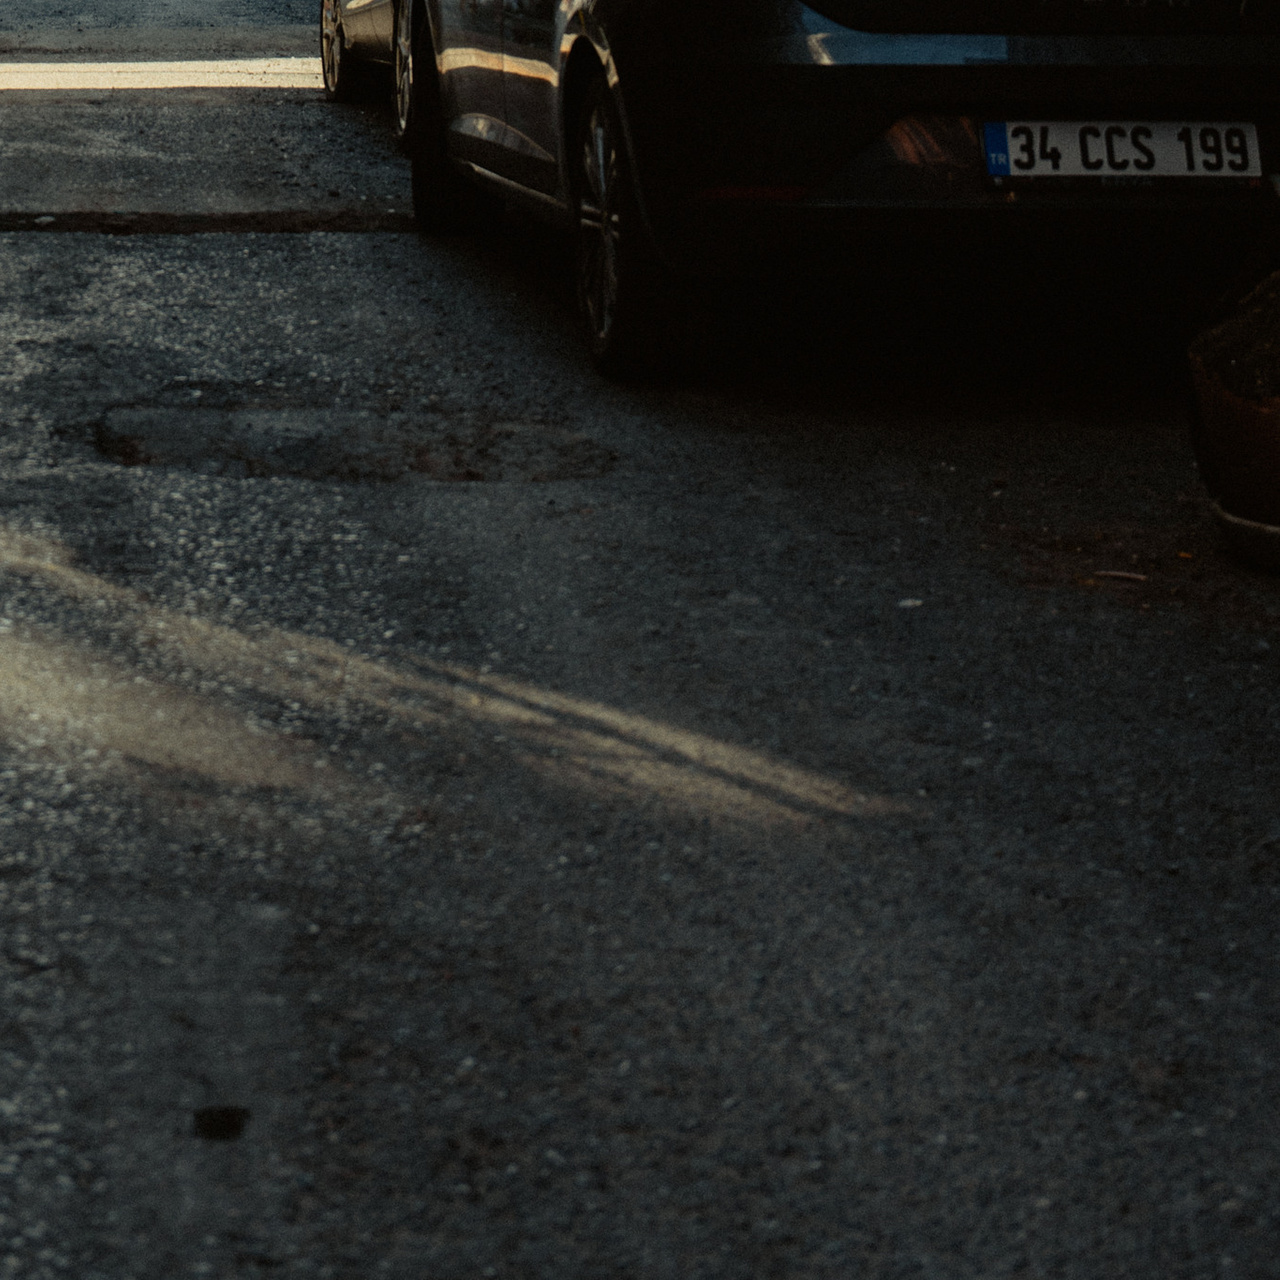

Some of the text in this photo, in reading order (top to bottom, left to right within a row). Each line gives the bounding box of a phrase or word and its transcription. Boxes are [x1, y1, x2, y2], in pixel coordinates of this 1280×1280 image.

[990, 153, 1007, 165] TR
[1011, 126, 1250, 171] 34 CCS 199
